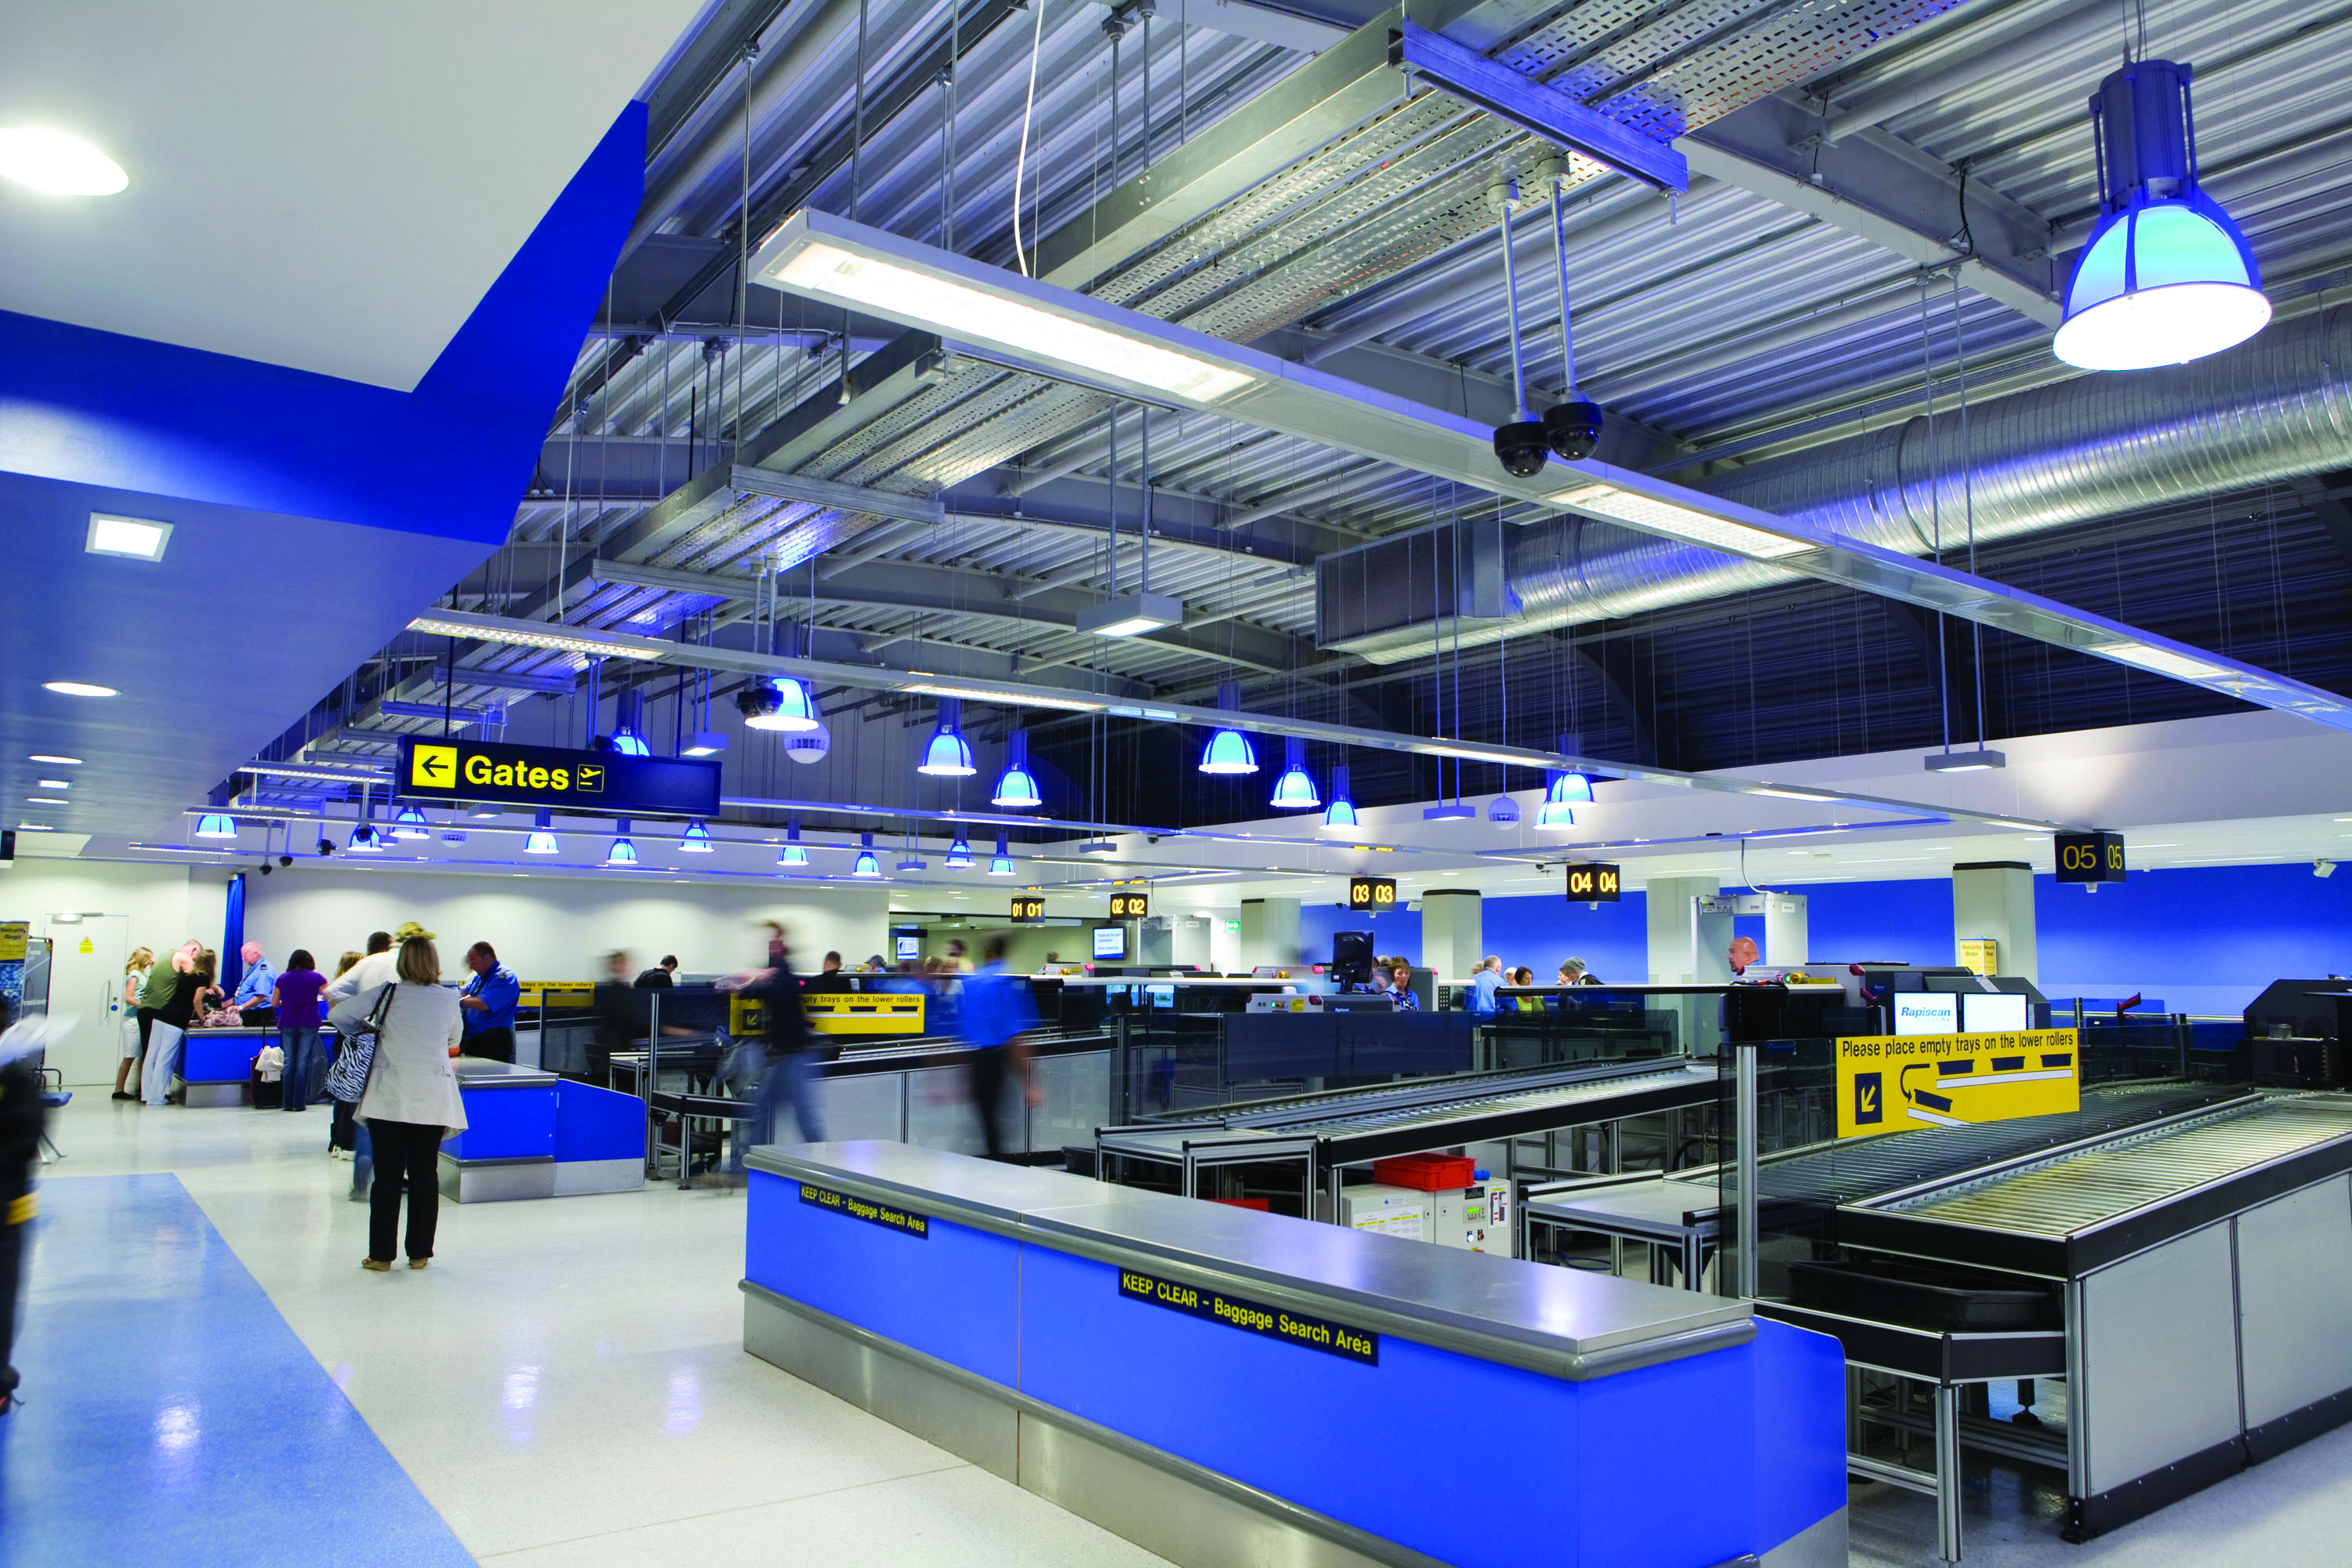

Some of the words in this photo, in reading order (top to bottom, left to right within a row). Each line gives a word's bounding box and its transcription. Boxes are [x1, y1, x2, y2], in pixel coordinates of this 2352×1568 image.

[465, 755, 569, 790] Gates
[2063, 844, 2096, 869] 05
[2107, 844, 2122, 869] 05
[1570, 872, 1592, 892] 04
[1599, 872, 1617, 892] 04
[1353, 884, 1370, 902] 03
[1375, 884, 1393, 903] 03
[1012, 903, 1022, 916] 01
[1027, 903, 1042, 917] 01
[1112, 898, 1123, 914] 02
[1128, 898, 1145, 915] 02
[1901, 1007, 1951, 1018] Rapiscan
[1842, 1040, 1880, 1057] Please
[1886, 1040, 1915, 1058] place
[1921, 1039, 1951, 1056] empty
[1956, 1038, 1980, 1052] trays
[1985, 1039, 1996, 1049] on
[2001, 1036, 2015, 1048] the
[2019, 1033, 2042, 1047] lower
[2047, 1032, 2073, 1046] rollers
[801, 1185, 818, 1200] KEEP
[818, 1190, 840, 1207] CLEAR
[848, 1199, 877, 1219] Baggage
[880, 1207, 905, 1225] Search
[907, 1216, 924, 1232] Area
[1123, 1272, 1153, 1294] KEEP
[1157, 1283, 1197, 1308] CLEAR
[1214, 1298, 1273, 1330] Baggage
[1279, 1315, 1330, 1344] Search
[1336, 1330, 1371, 1355] Area
